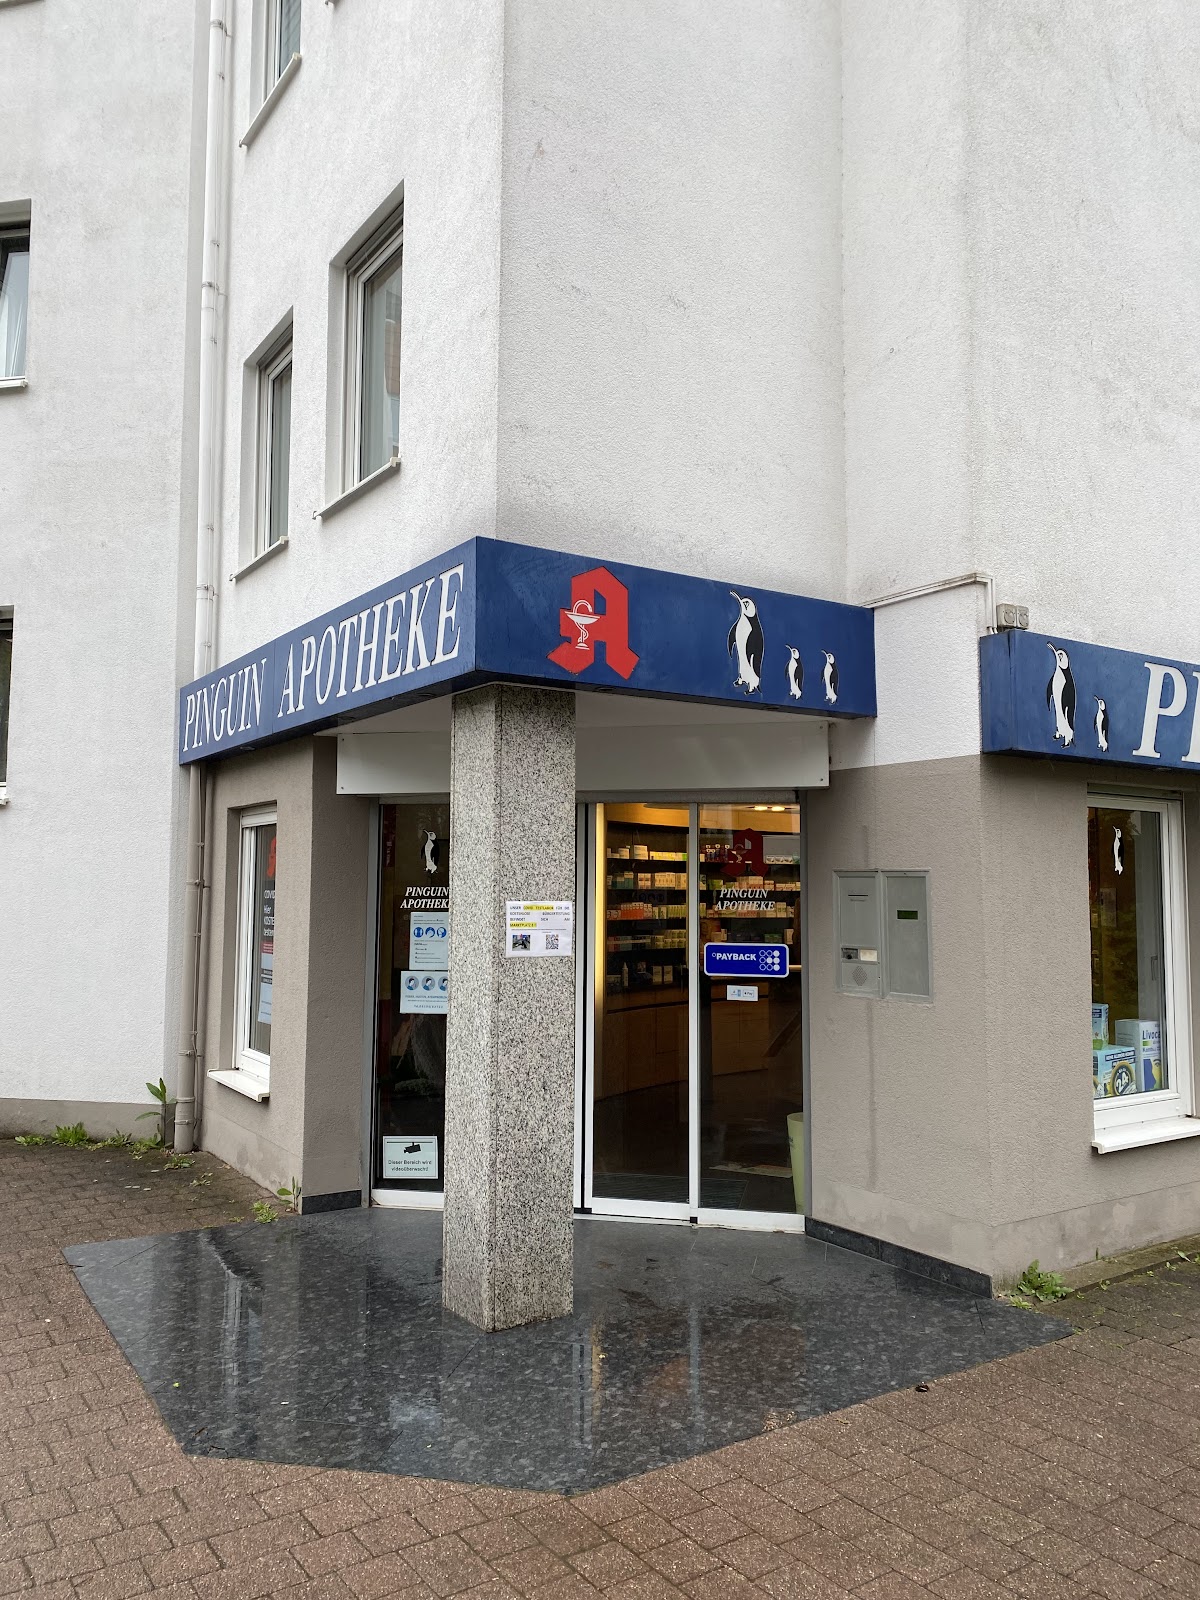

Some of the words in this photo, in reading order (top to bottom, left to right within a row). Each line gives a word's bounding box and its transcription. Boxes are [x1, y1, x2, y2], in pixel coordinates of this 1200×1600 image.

[183, 658, 267, 752] PINGUIN
[277, 563, 464, 718] APOTHEKE
[405, 886, 449, 897] PINGUIN
[720, 888, 768, 898] PINGUIN
[715, 901, 775, 911] APOTHEKE
[716, 952, 756, 961] PAYBACK
